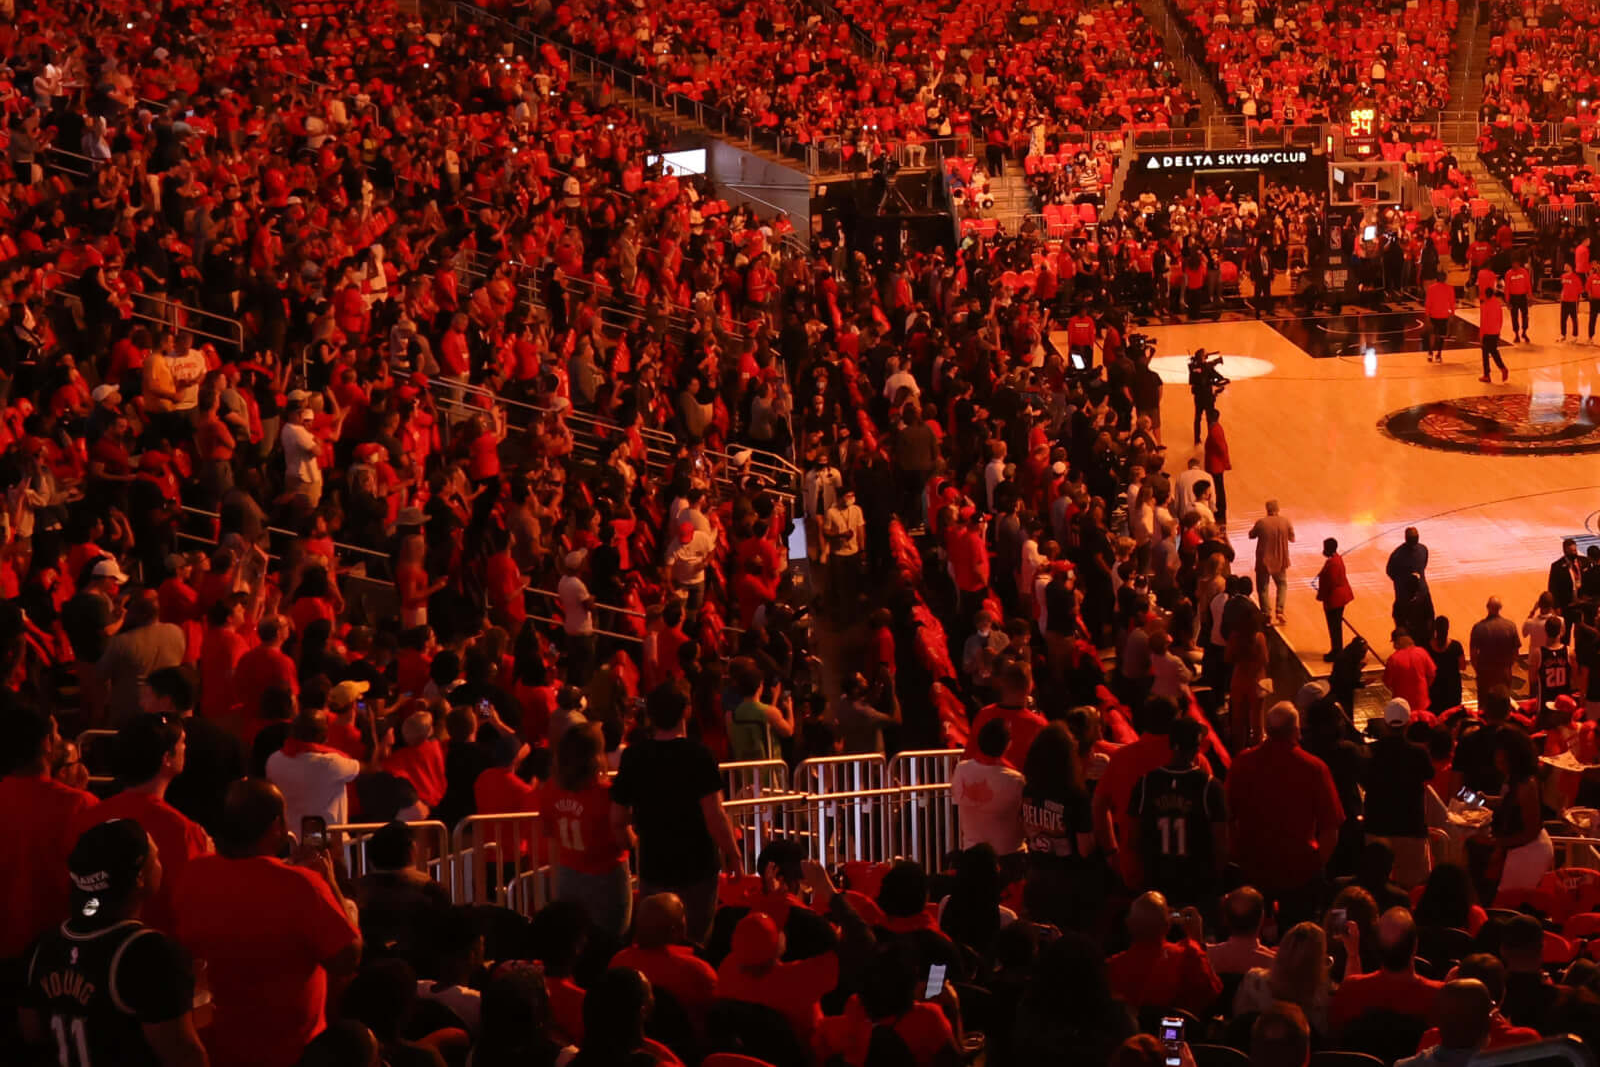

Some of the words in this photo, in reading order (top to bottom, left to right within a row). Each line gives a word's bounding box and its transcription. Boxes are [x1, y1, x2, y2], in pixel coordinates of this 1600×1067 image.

[1350, 119, 1371, 136] 24
[1163, 154, 1214, 168] DELTA
[556, 816, 585, 852] 11
[1022, 803, 1067, 832] BELIEVE
[1156, 816, 1187, 856] 11
[39, 968, 97, 1006] YOUNG
[50, 1013, 95, 1067] 11
